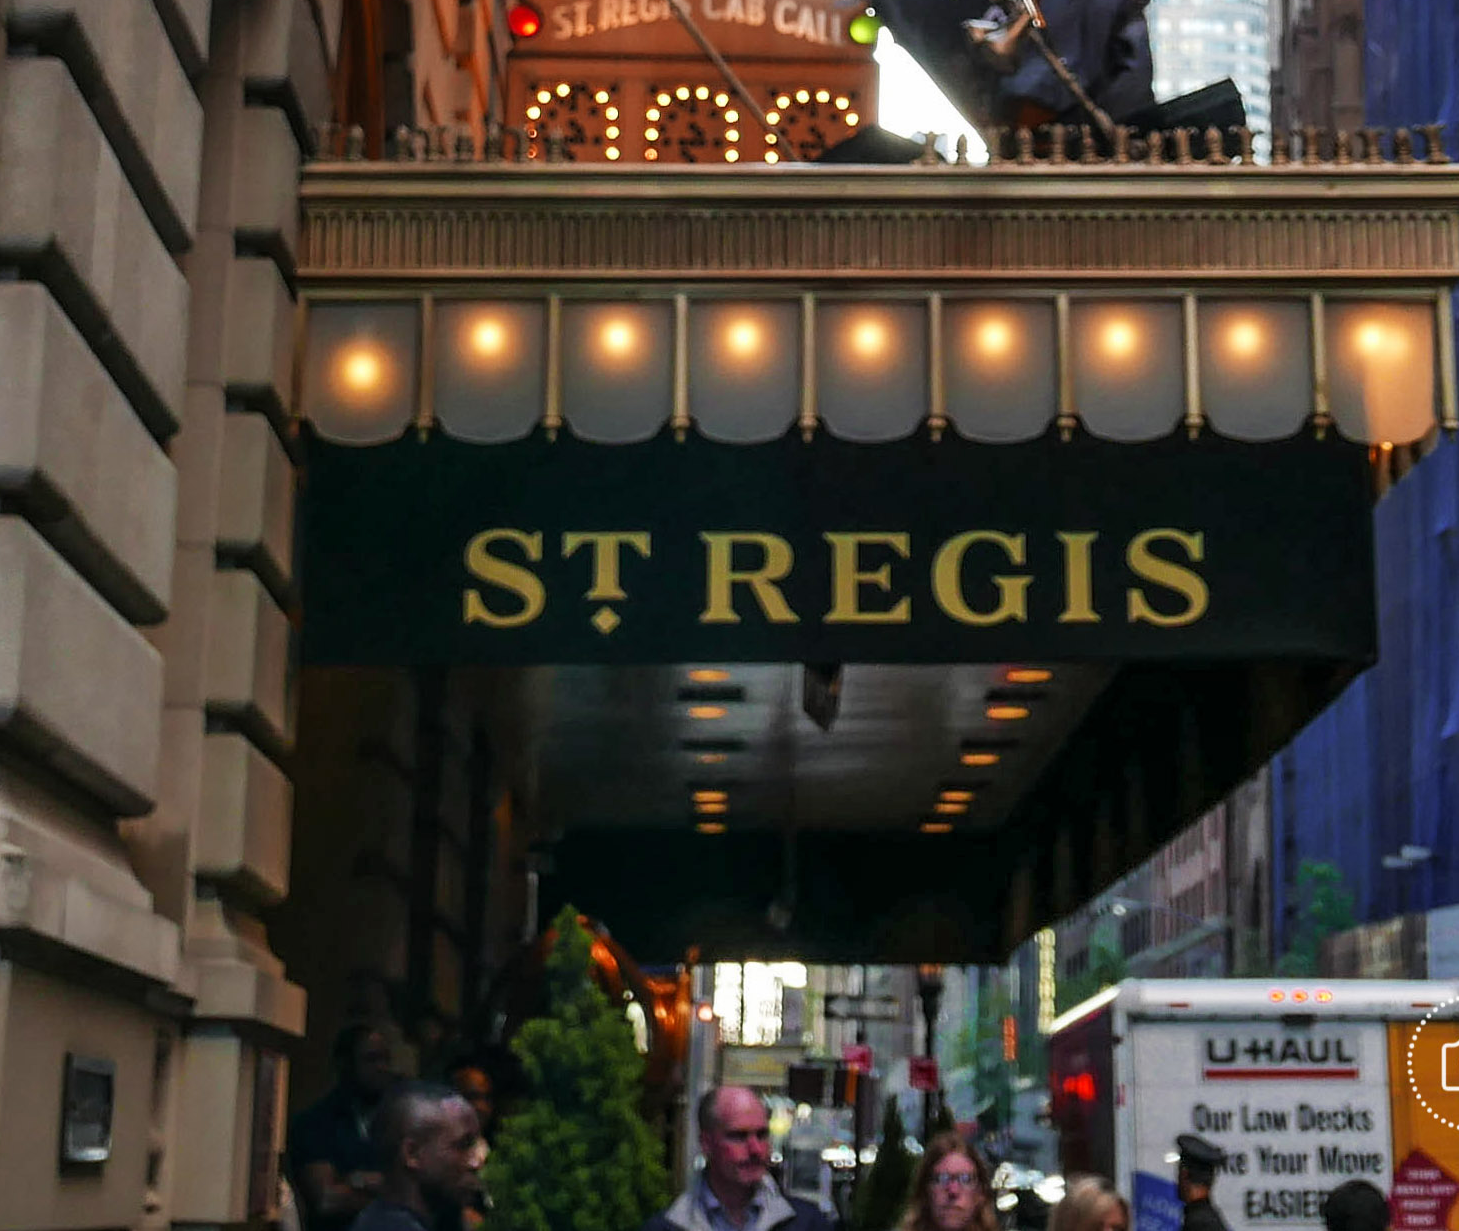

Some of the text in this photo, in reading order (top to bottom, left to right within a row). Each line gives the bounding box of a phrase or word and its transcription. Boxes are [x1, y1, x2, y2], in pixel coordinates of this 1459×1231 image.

[697, 526, 1211, 629] REGIS
[1207, 1038, 1355, 1064] U-HAUL
[1193, 1102, 1375, 1133] Our Low Decks
[1255, 1144, 1309, 1176] Your
[1318, 1144, 1384, 1176] Move
